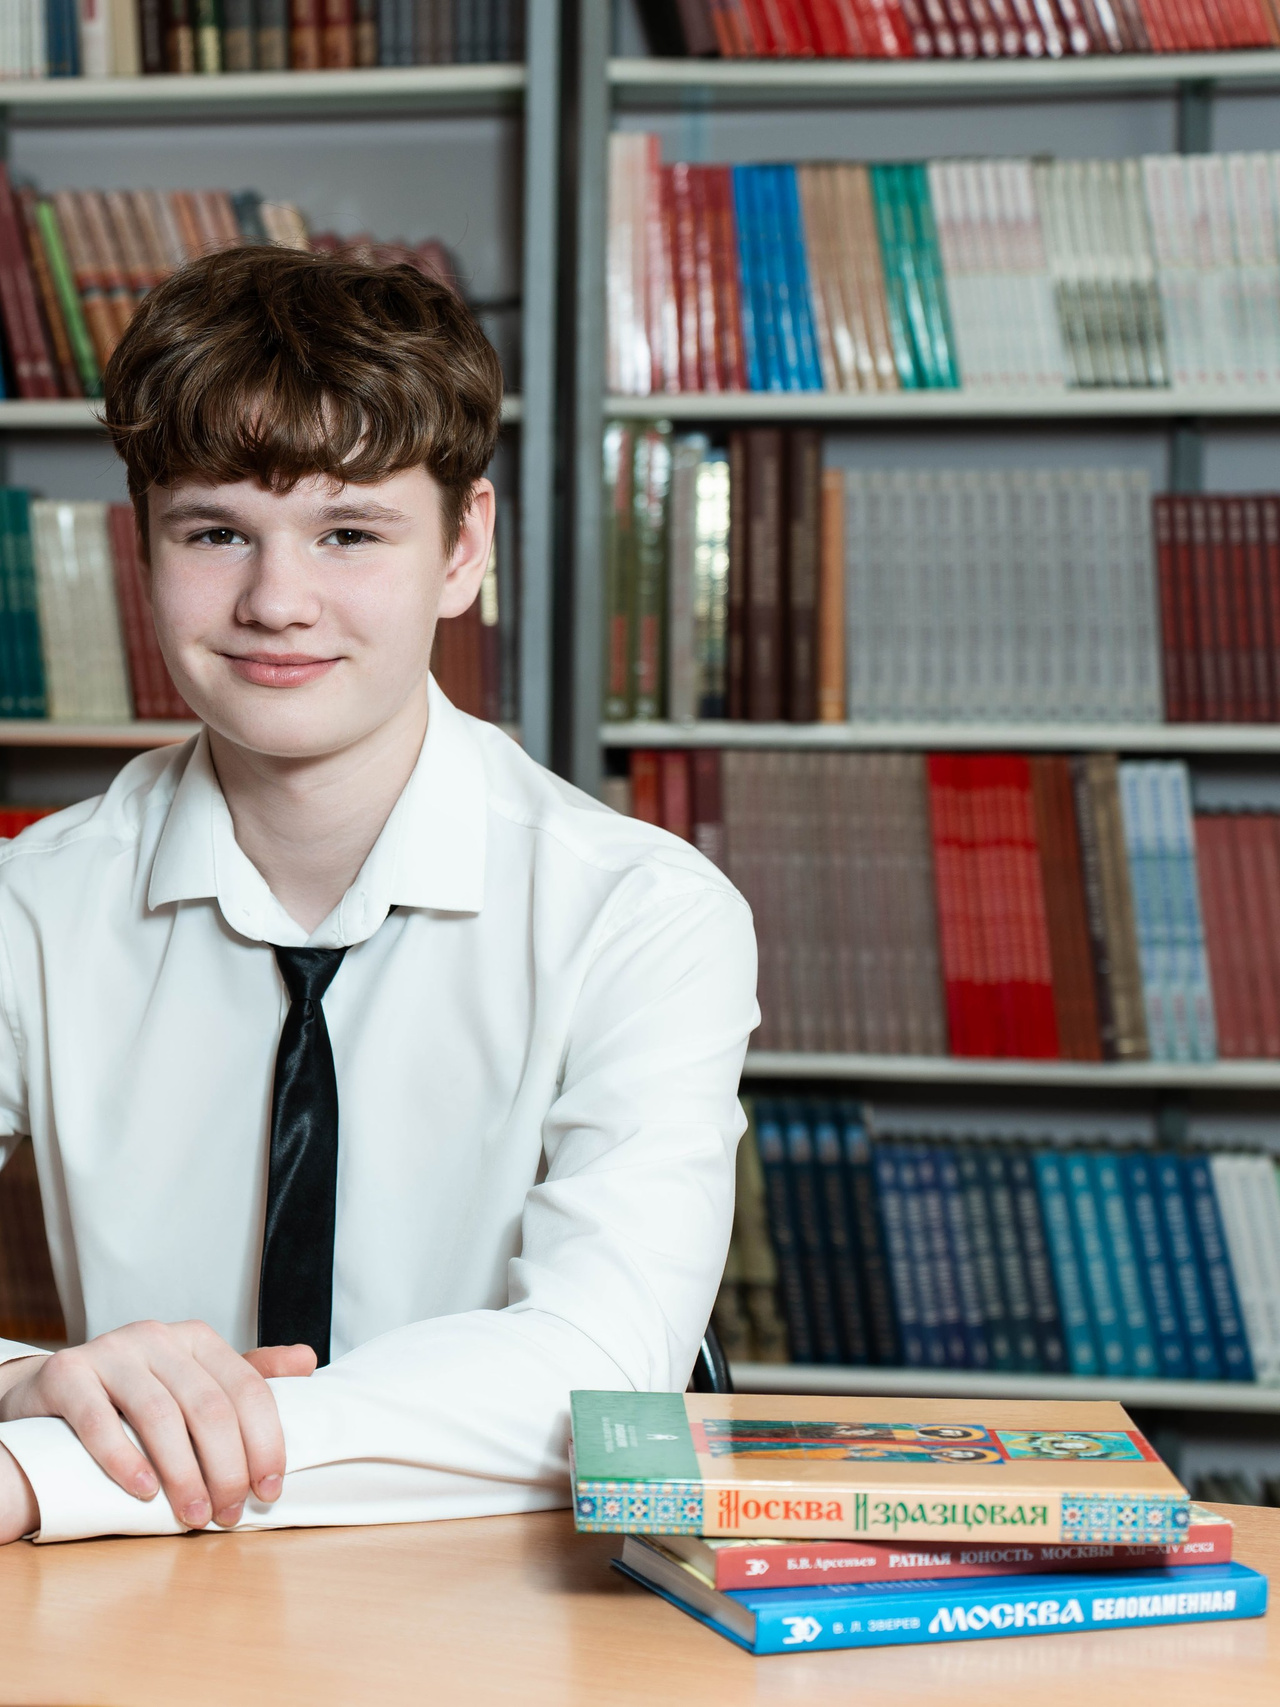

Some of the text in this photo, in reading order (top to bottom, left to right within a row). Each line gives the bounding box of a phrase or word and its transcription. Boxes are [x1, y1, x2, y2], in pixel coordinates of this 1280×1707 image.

[718, 1489, 1048, 1532] Москва Изразцовая
[816, 1556, 876, 1572] Арсеньев
[888, 1552, 952, 1568] РАТНАЯ
[960, 1548, 1034, 1565] ЮНОСТЬ
[1041, 1544, 1115, 1561] МОСКВЫ
[1183, 1541, 1215, 1554] века
[832, 1621, 847, 1635] В.
[867, 1616, 921, 1632] ЗВЕРЕВ
[927, 1597, 1085, 1634] МОСКВА
[1091, 1589, 1237, 1622] БЕЛОКАМЕННАЯ
